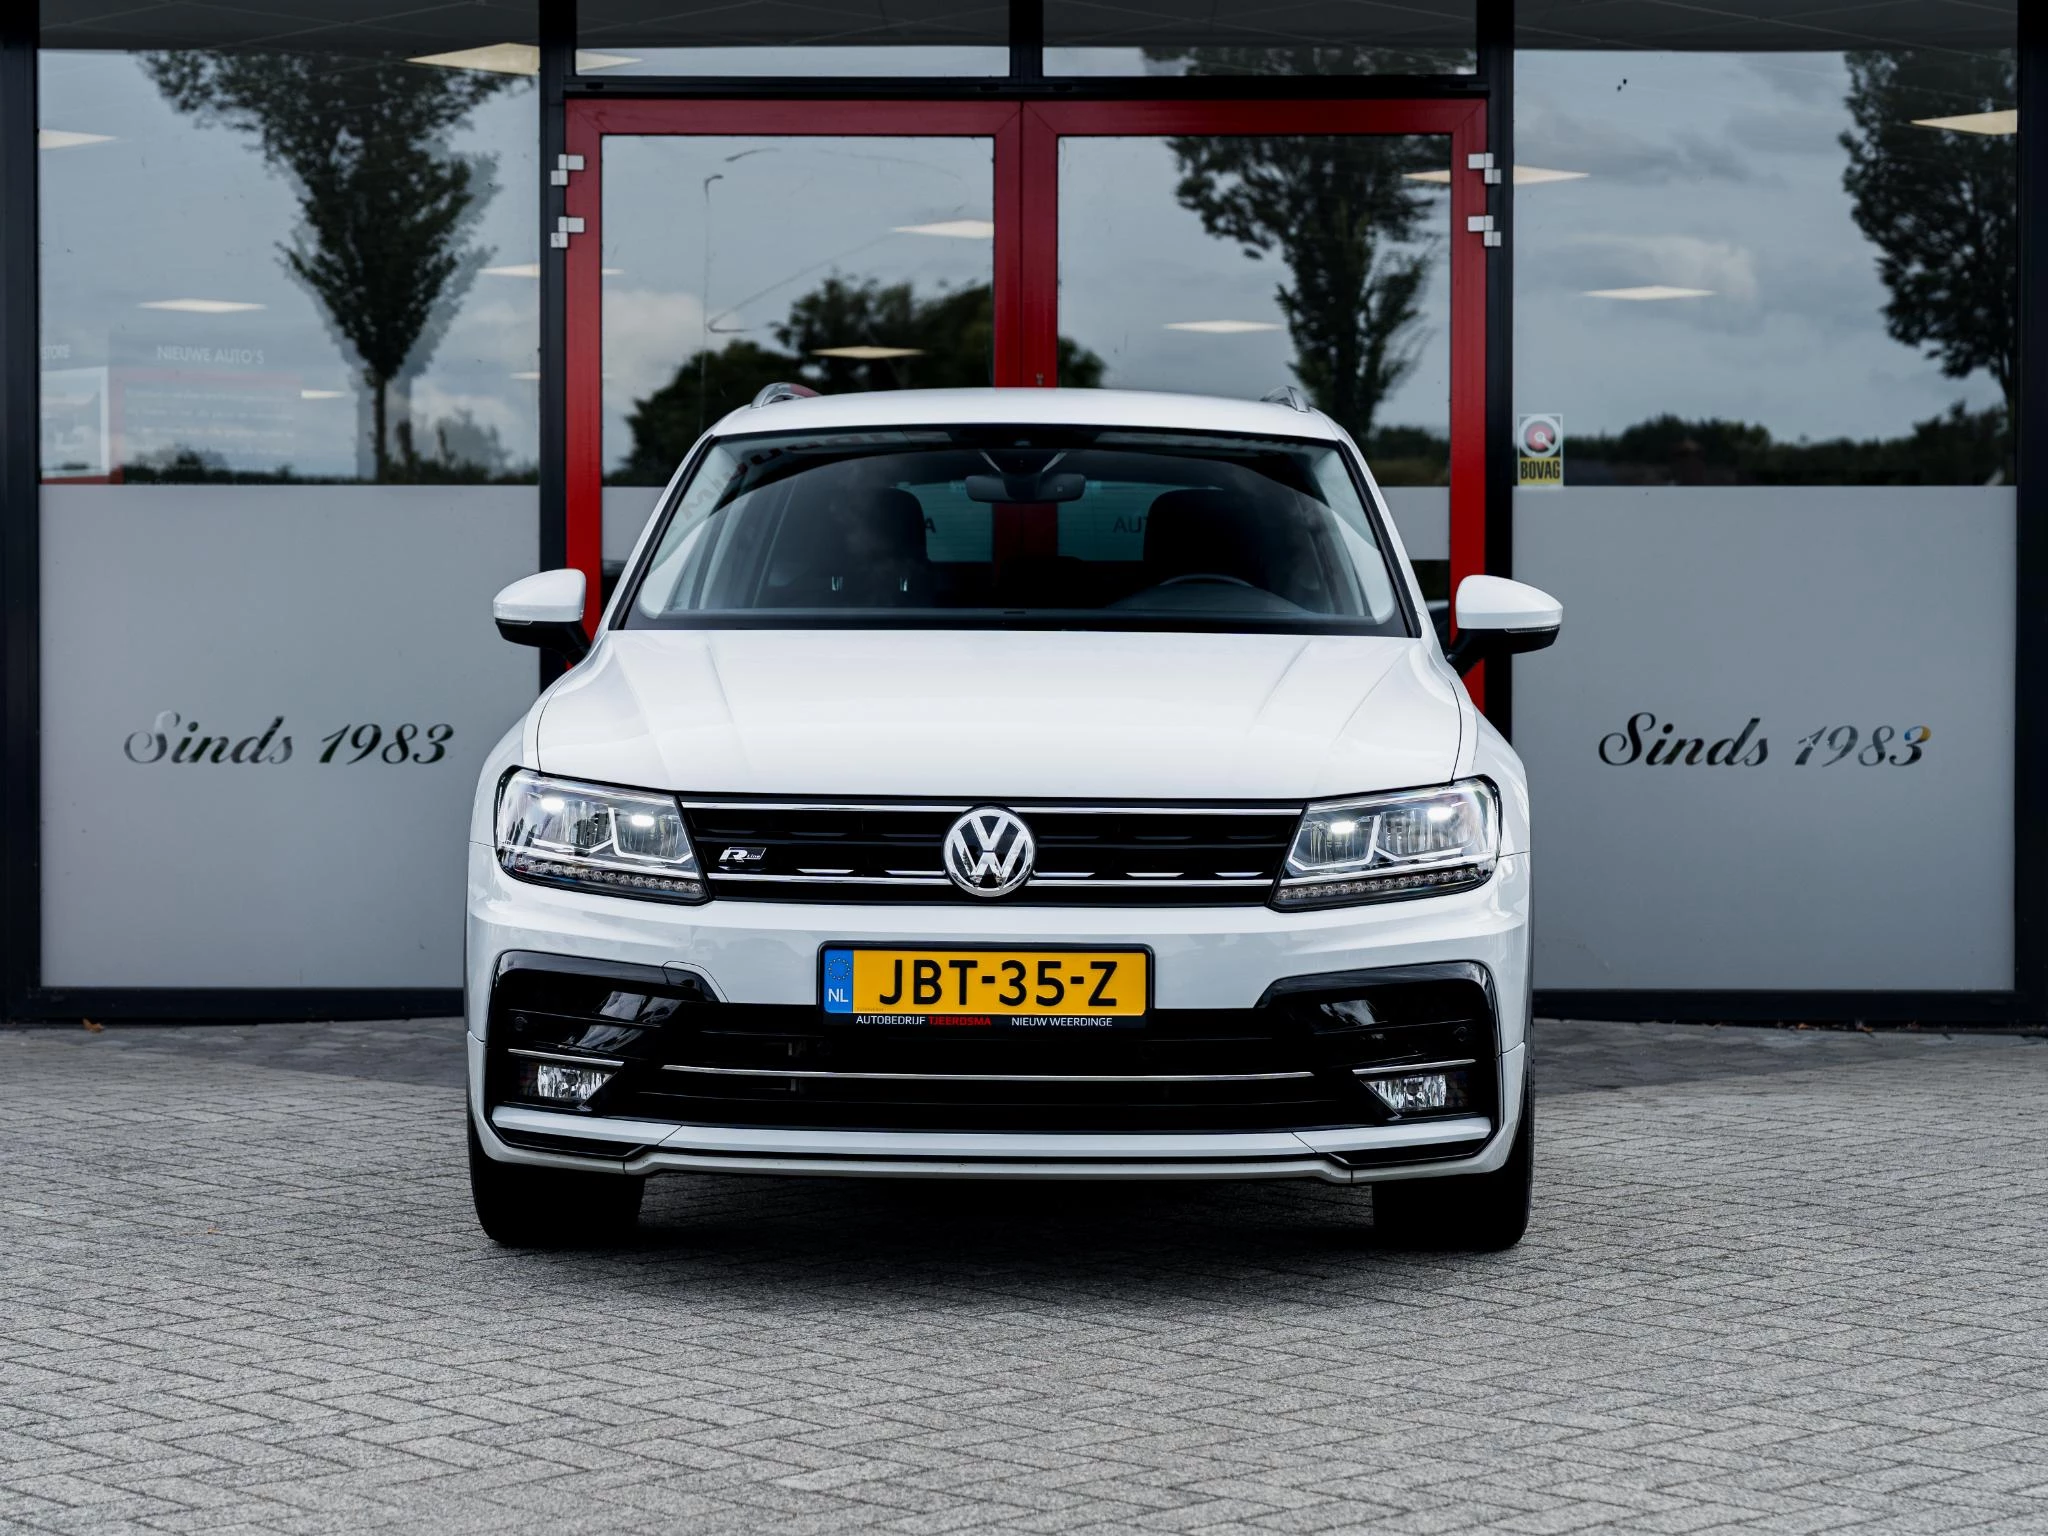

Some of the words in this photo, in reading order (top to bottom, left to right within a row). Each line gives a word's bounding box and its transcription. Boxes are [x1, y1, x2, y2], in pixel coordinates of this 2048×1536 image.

[157, 345, 210, 363] NIEUWE
[214, 347, 265, 365] AUTO'S
[1520, 460, 1561, 480] BOVAG
[123, 709, 293, 765] Sinds
[318, 723, 455, 766] 1983
[1598, 711, 1769, 767] Sinds
[1794, 725, 1932, 767] 1983
[878, 959, 1119, 1008] JBT-35-Z
[828, 988, 849, 1003] NL
[856, 1015, 926, 1025] AUTOBEDRIJF
[928, 1016, 992, 1026] TJEERDSMA
[1011, 1017, 1048, 1027] NIEUW
[1049, 1017, 1113, 1027] WEERDINGE
